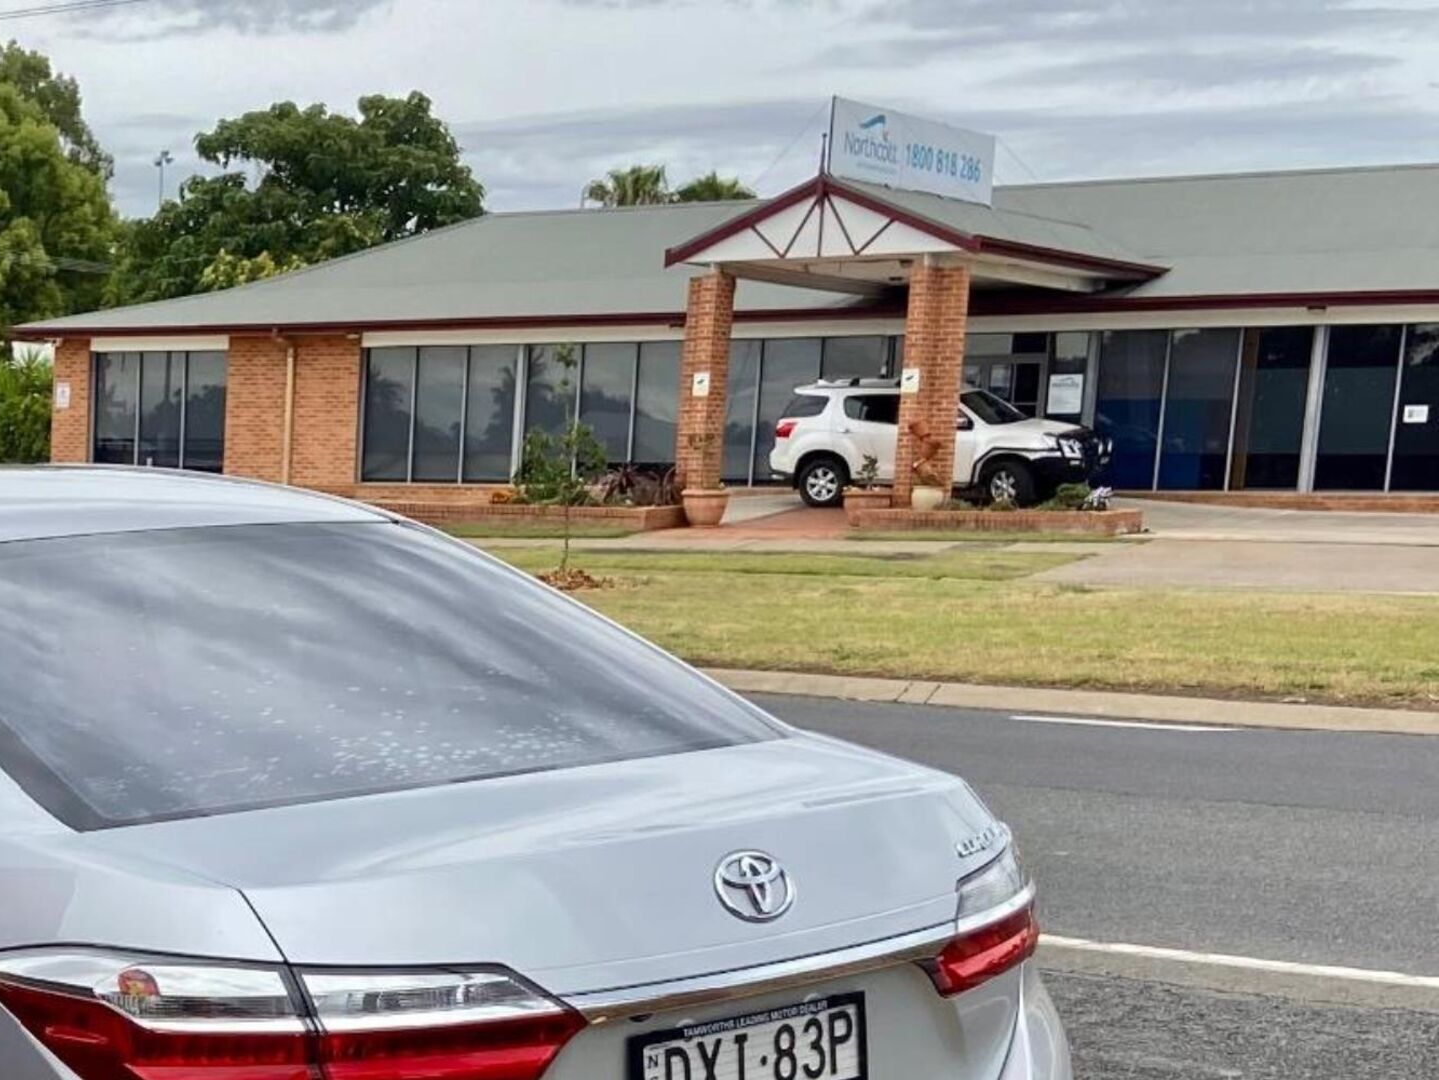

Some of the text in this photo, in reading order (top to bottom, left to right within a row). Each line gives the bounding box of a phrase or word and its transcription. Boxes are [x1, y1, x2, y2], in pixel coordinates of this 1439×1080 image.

[844, 131, 899, 165] Northcott
[906, 143, 934, 171] 1800
[936, 149, 957, 176] 818
[961, 154, 981, 182] 286
[771, 1007, 798, 1021] MOTOR
